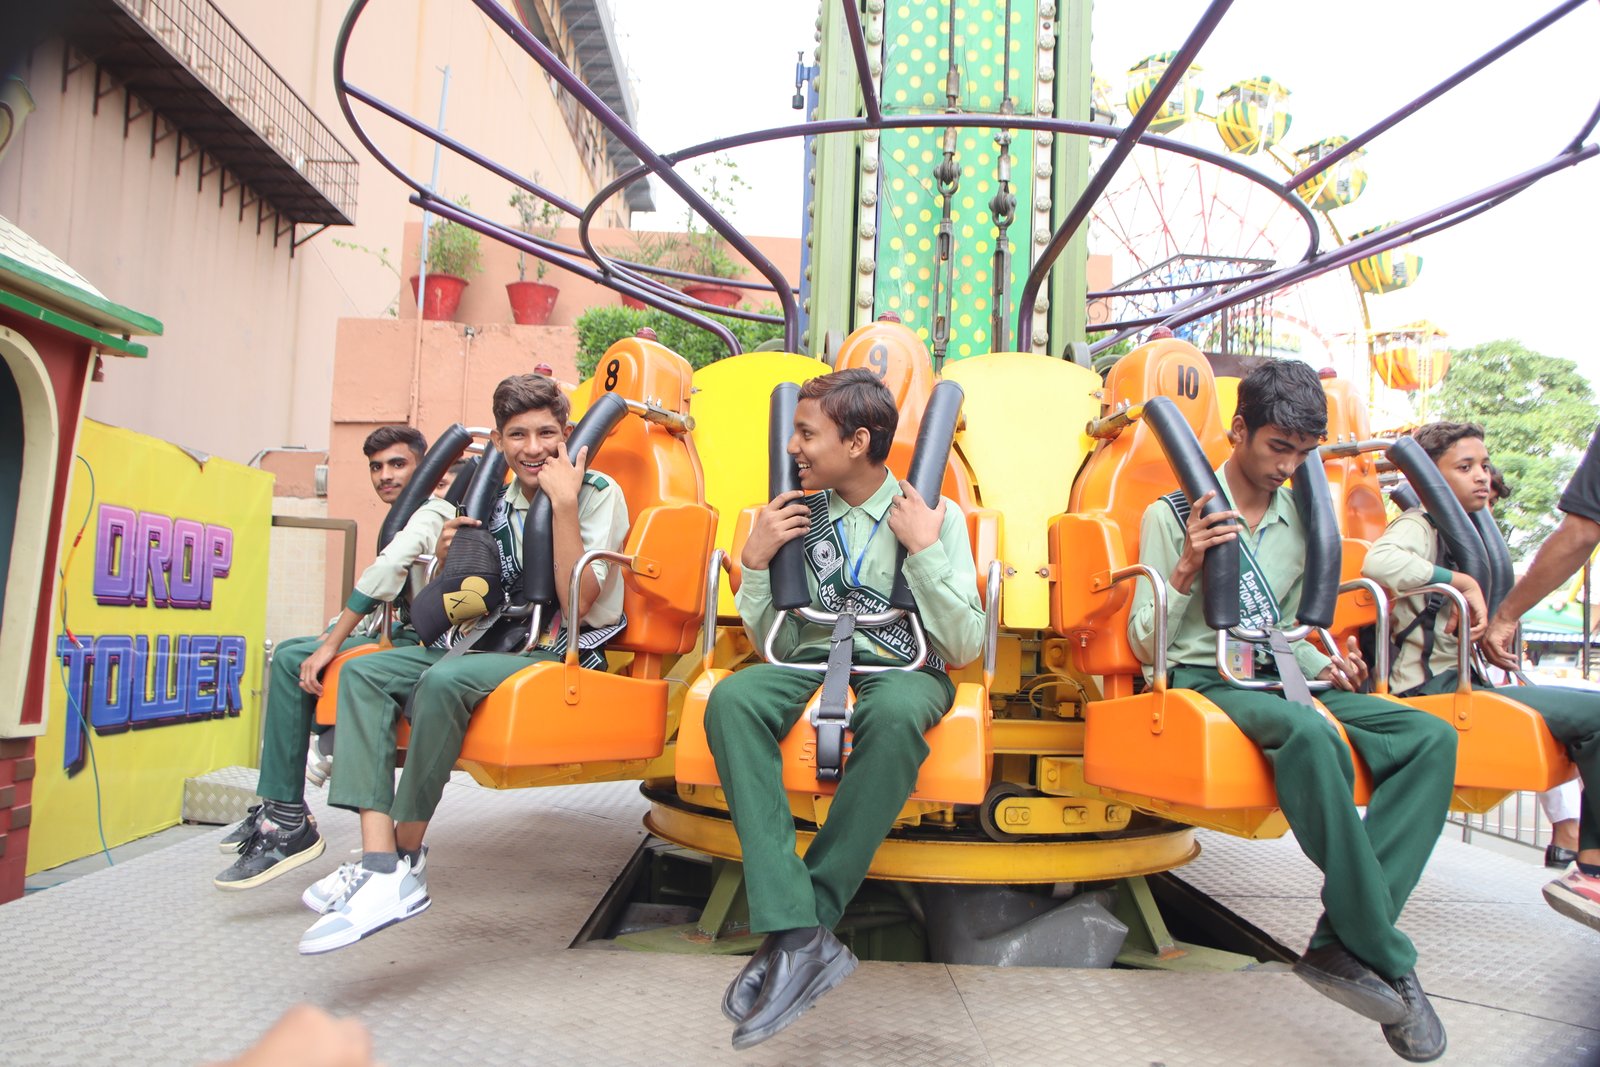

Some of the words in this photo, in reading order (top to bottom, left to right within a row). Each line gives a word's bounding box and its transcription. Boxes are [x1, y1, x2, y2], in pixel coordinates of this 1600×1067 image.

[605, 359, 620, 391] 8
[869, 344, 888, 380] 9
[1177, 365, 1199, 400] 10
[93, 503, 234, 609] DROP
[870, 625, 917, 659] AMPUS
[56, 634, 247, 779] TOWER
